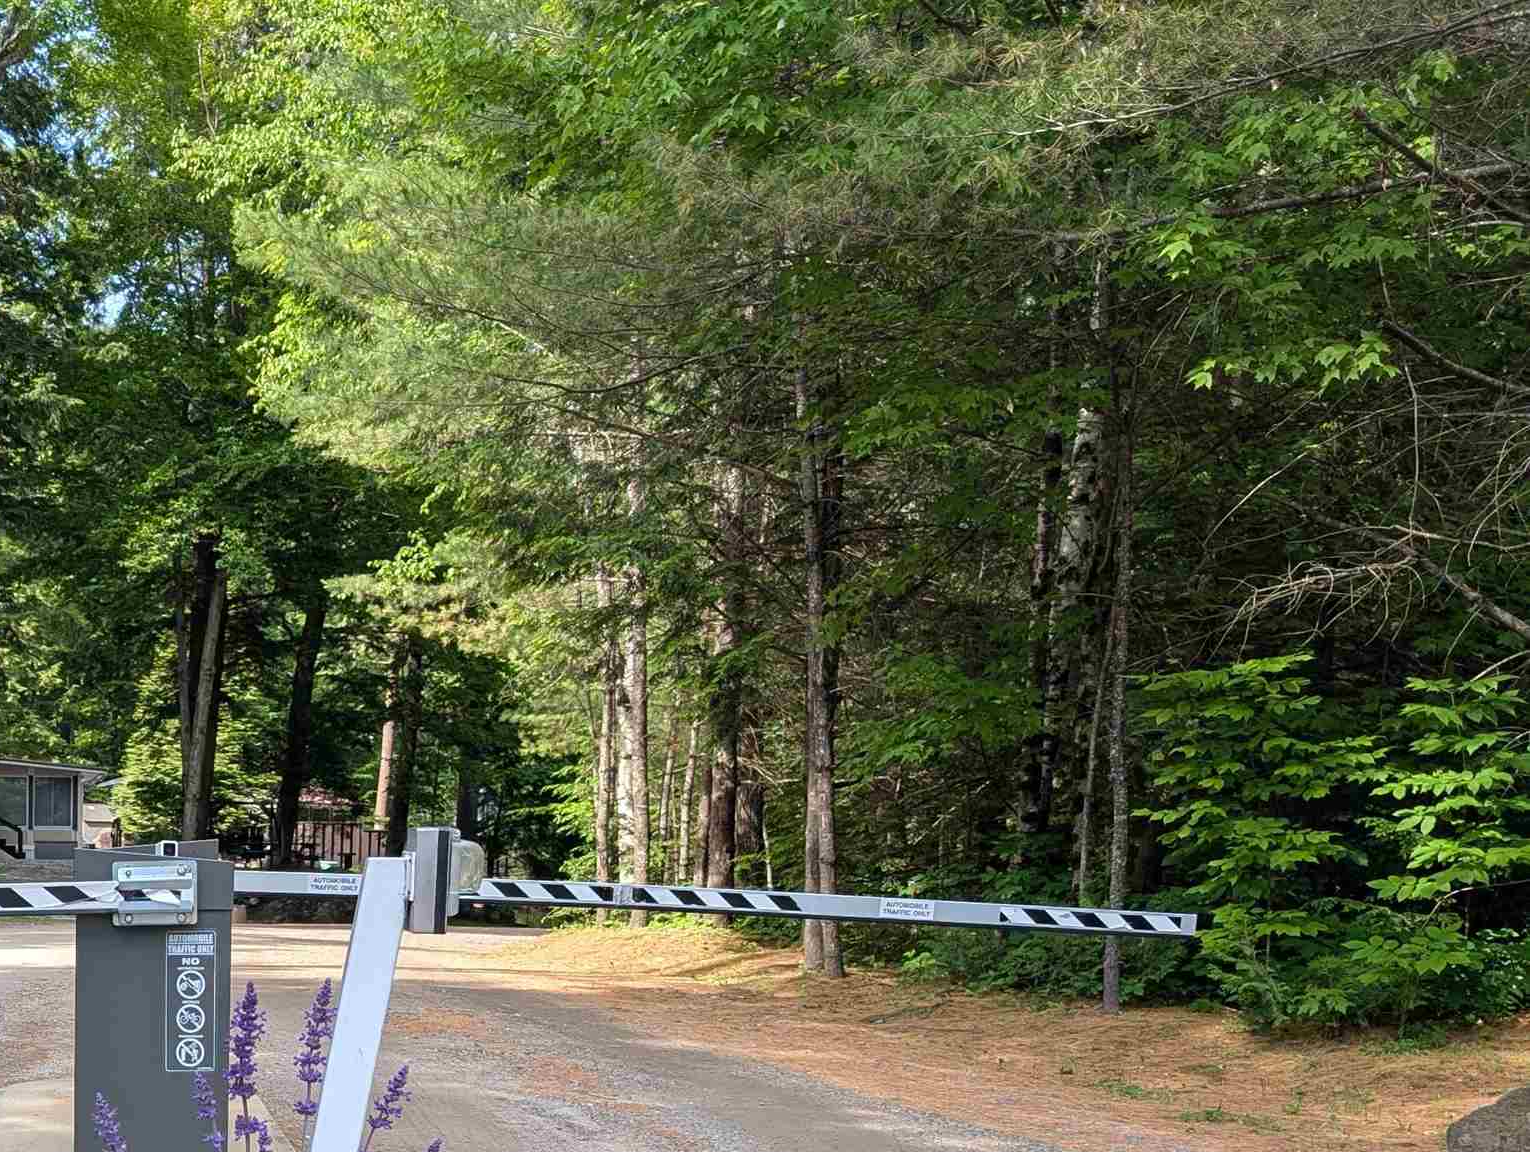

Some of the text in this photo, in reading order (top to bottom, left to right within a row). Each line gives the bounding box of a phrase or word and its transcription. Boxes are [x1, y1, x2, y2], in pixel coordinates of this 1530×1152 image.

[169, 934, 214, 944] AUTOMOBILE
[168, 945, 214, 953] TRAFFIC ONLY
[182, 957, 200, 966] NO
